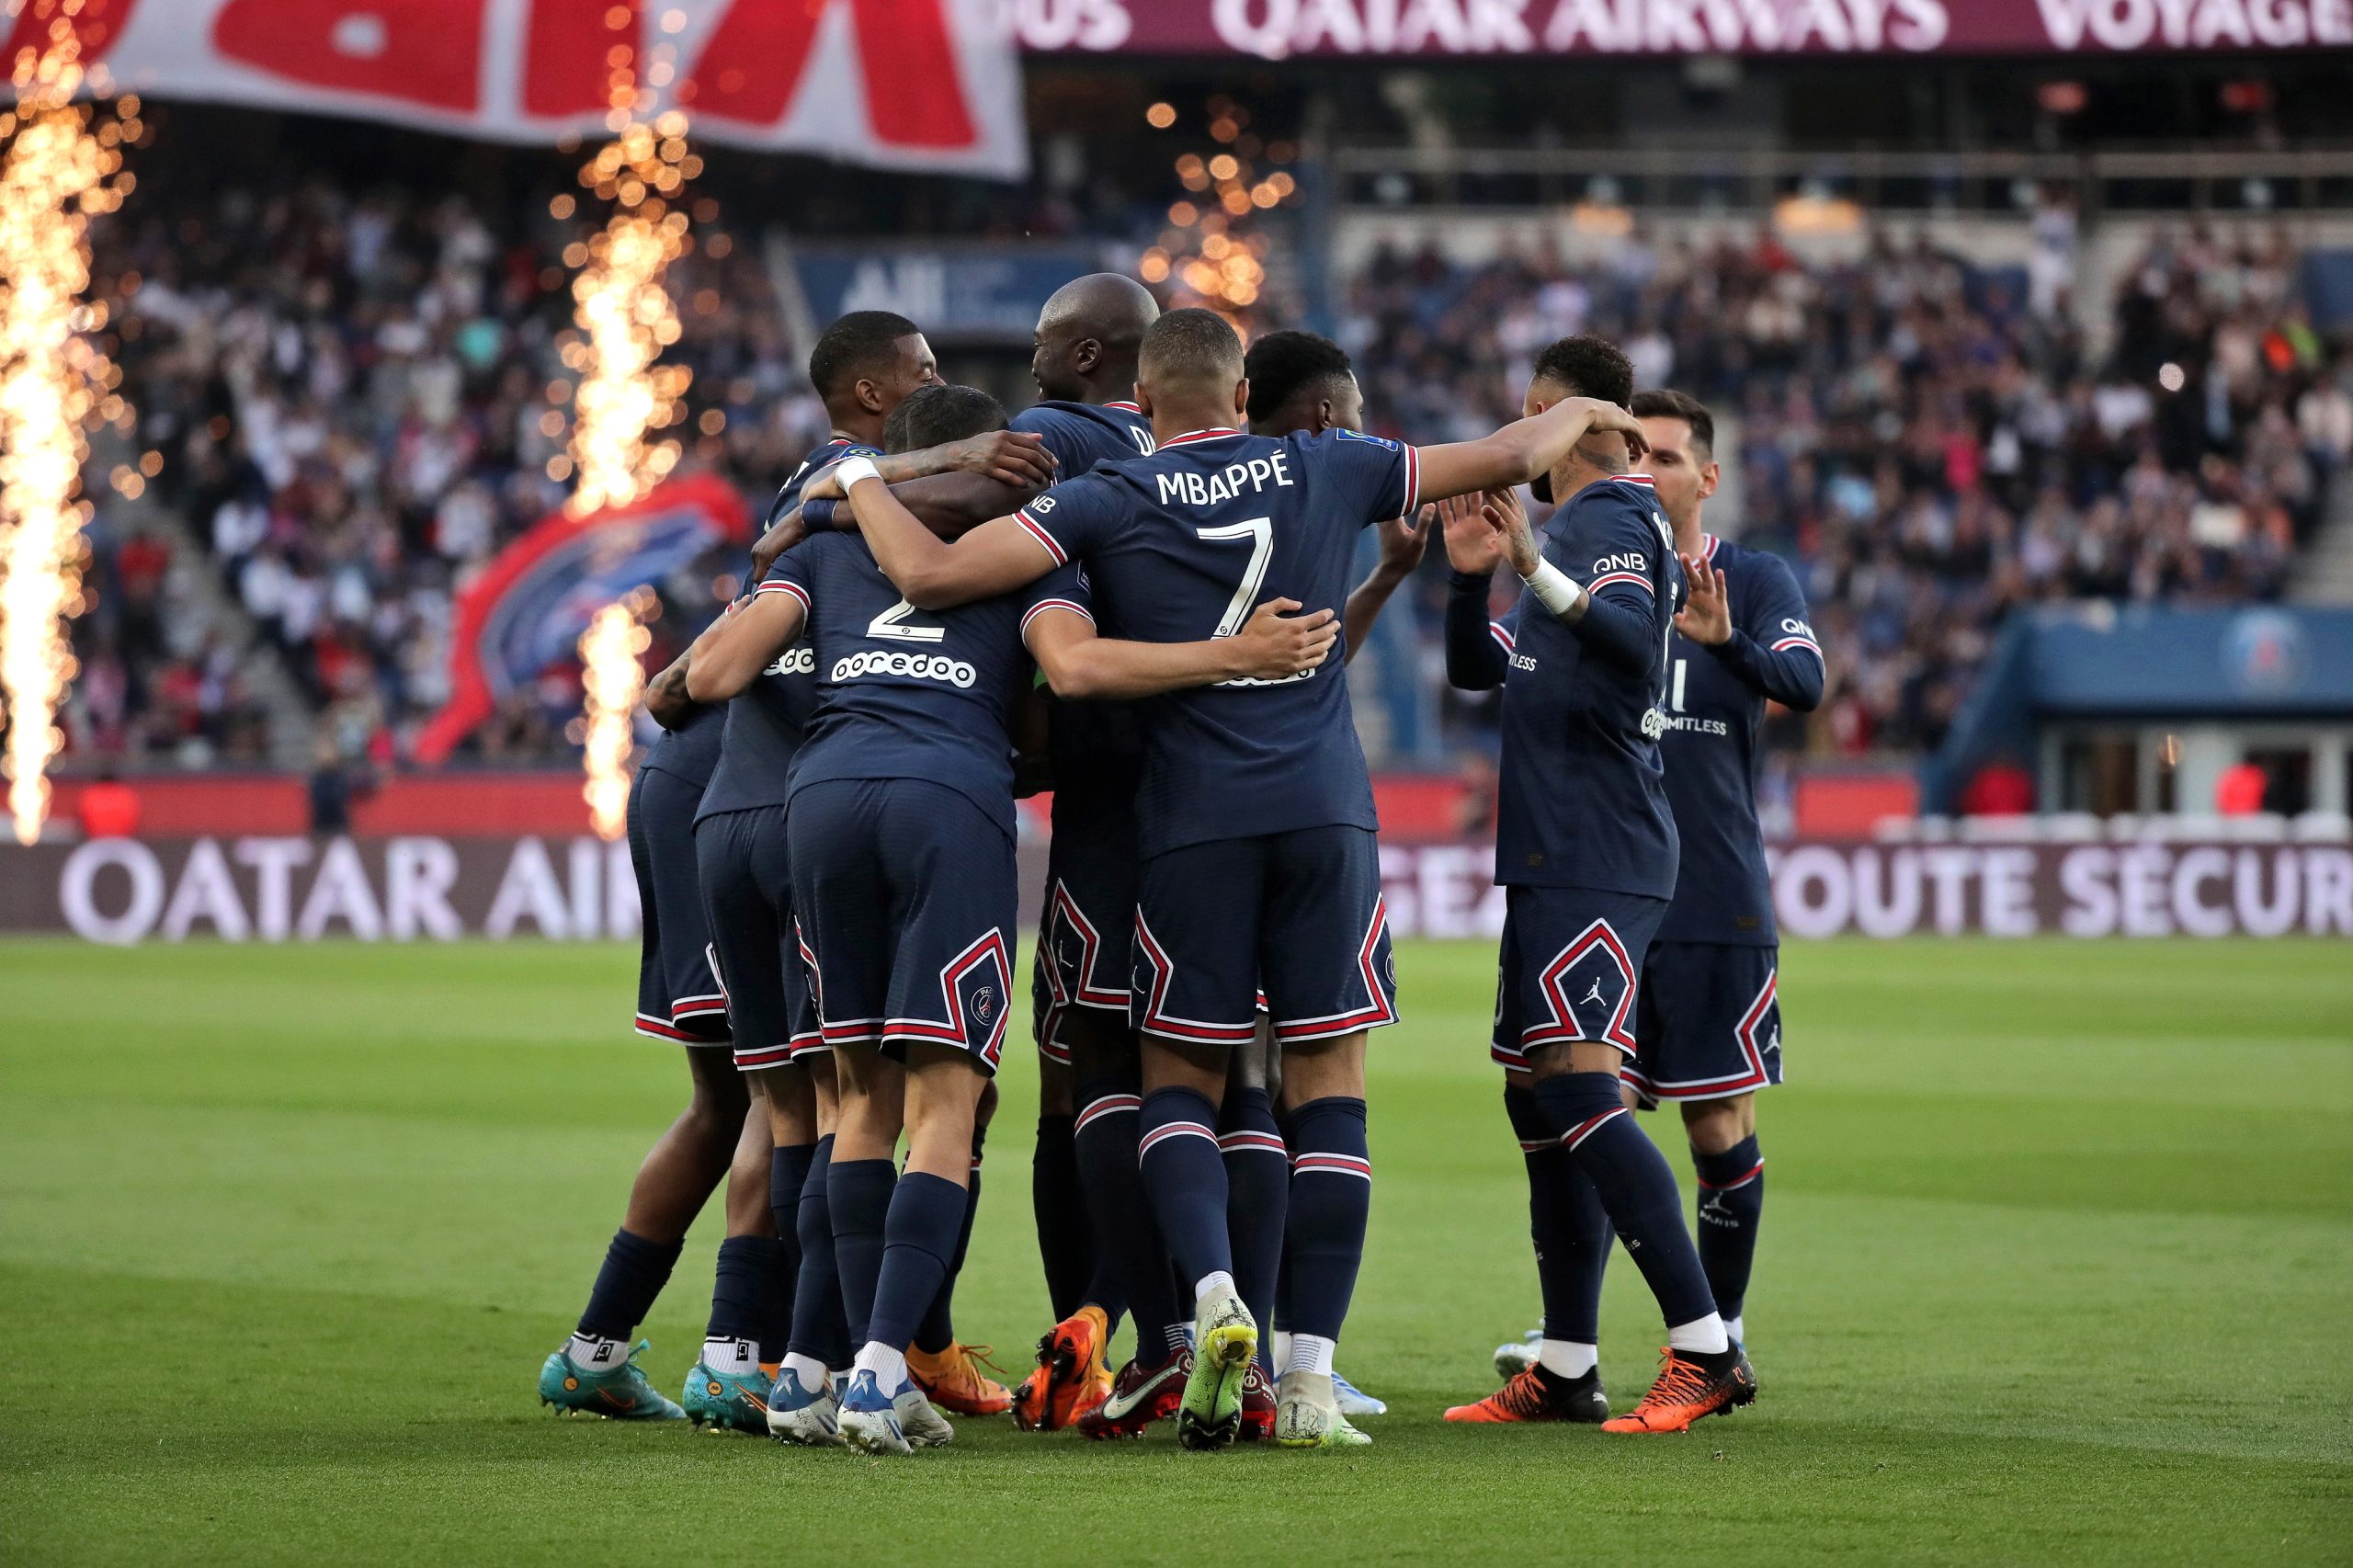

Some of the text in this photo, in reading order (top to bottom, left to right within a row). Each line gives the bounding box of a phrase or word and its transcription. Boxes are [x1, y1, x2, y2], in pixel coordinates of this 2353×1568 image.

[1211, 0, 1533, 58] QATAR
[1544, 0, 1949, 51] AIRWAYS
[1027, 495, 1056, 514] NB
[1155, 449, 1294, 506] MBAPPÉ
[1196, 517, 1274, 641] 7
[1781, 618, 1818, 643] QN
[831, 651, 977, 687] ooredoo
[1664, 716, 1727, 737] IMITLESS
[60, 835, 463, 946] QATAR
[1767, 845, 2039, 938] OUTE
